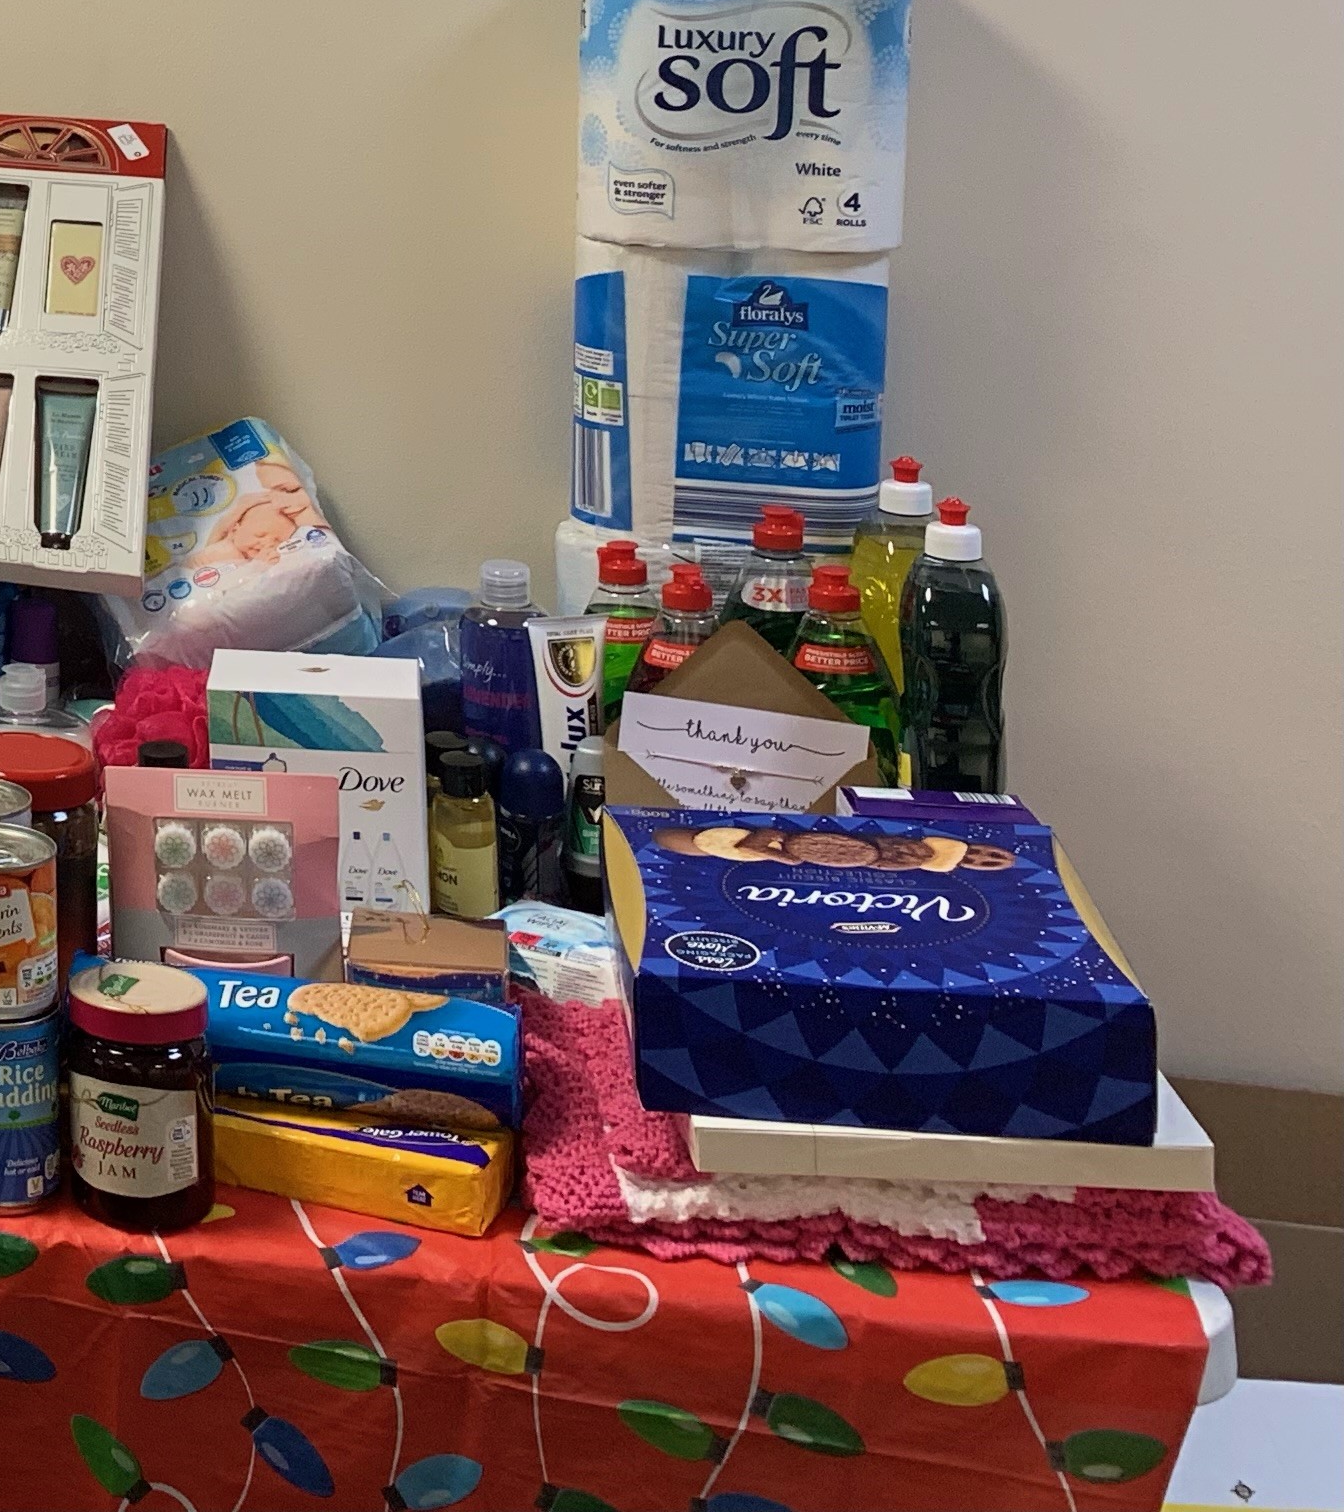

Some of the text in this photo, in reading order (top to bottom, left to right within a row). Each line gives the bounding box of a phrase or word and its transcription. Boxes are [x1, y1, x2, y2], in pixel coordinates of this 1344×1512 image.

[658, 25, 775, 58] Luxury
[654, 26, 841, 141] soft
[650, 138, 665, 148] For
[666, 142, 701, 152] softness
[703, 142, 719, 151] and
[720, 134, 756, 148] strength
[795, 130, 819, 139] every
[796, 163, 841, 177] White
[844, 193, 861, 212] 4
[836, 218, 866, 227] ROLLS
[740, 306, 804, 325] floralys
[708, 321, 797, 351] Super
[746, 350, 824, 392] Soft
[753, 586, 782, 604] 3X
[686, 719, 792, 753] thank you
[339, 767, 405, 793] Dove
[186, 788, 253, 800] WAX MELT
[738, 883, 976, 925] Victoria
[218, 980, 280, 1009] Tea
[95, 1116, 139, 1136] Seedless
[80, 1126, 165, 1165] Raspberry
[98, 1160, 136, 1179] JAM
